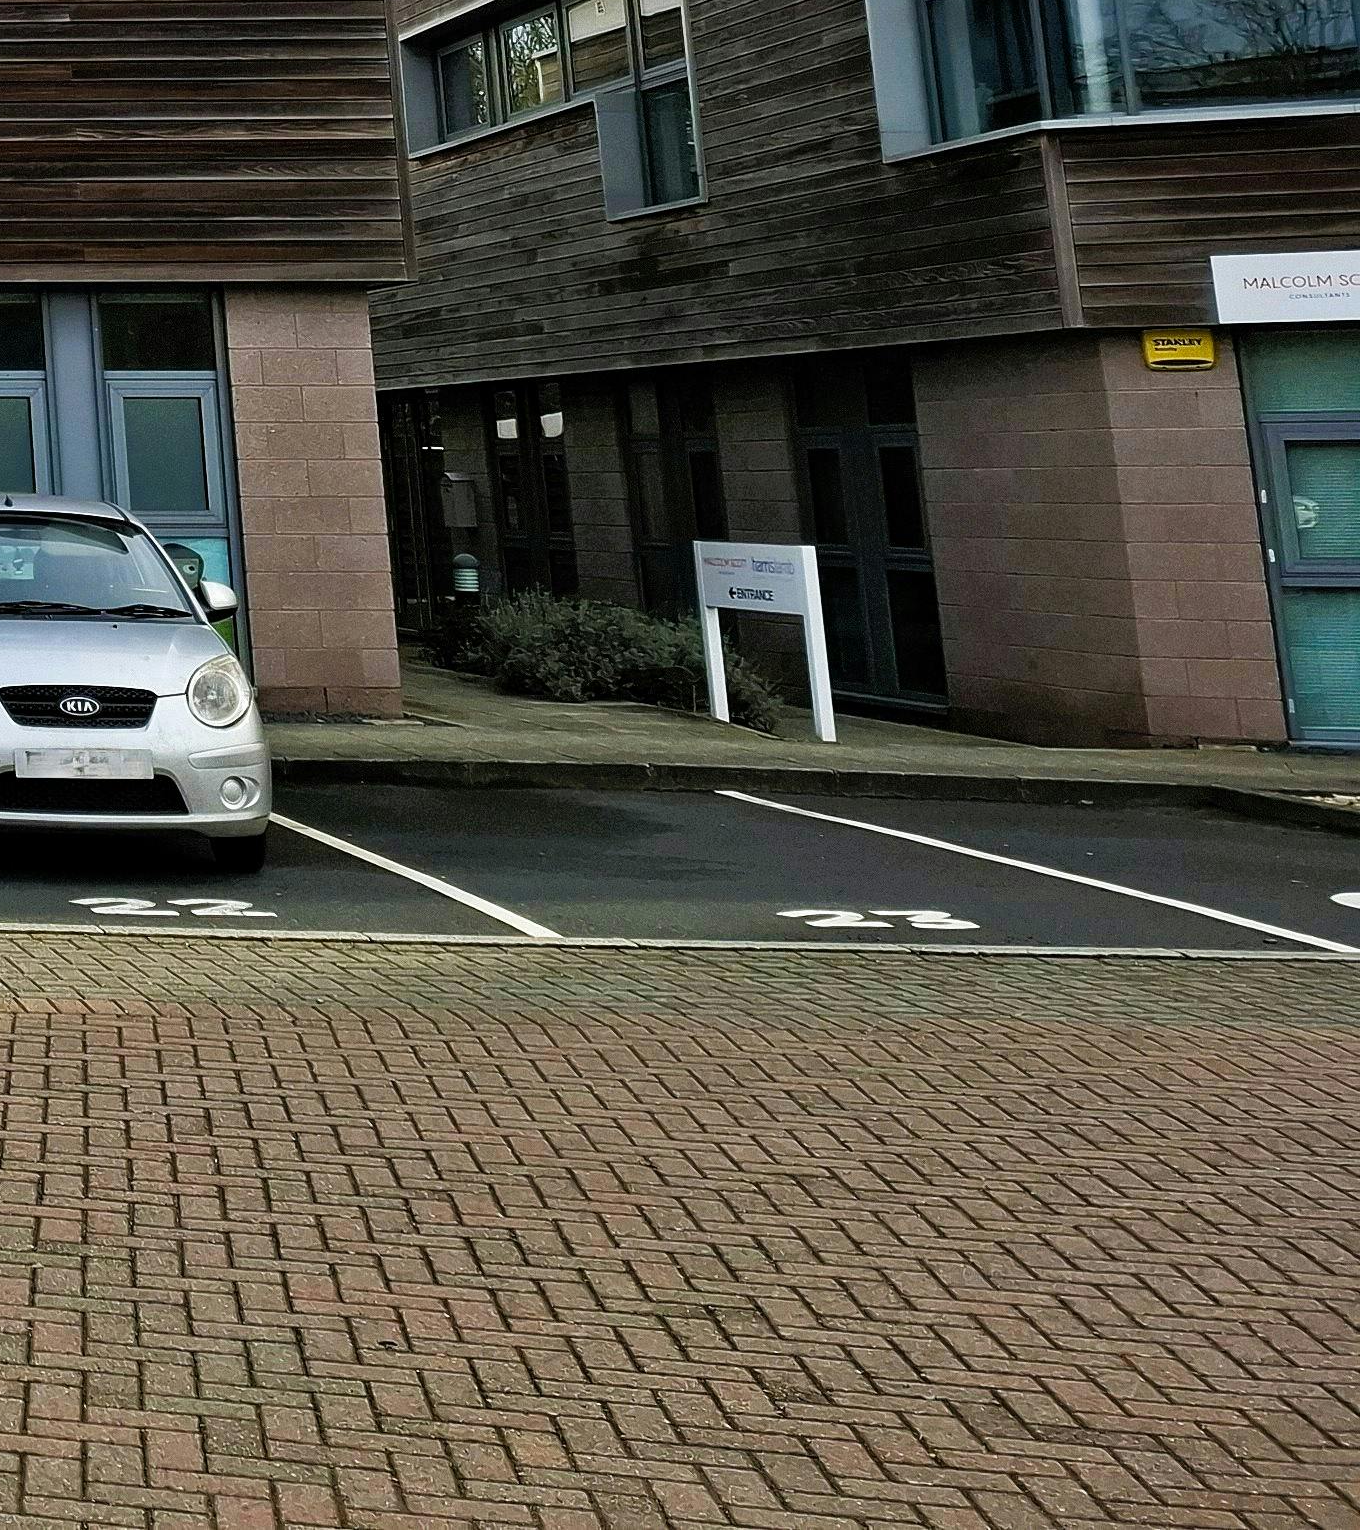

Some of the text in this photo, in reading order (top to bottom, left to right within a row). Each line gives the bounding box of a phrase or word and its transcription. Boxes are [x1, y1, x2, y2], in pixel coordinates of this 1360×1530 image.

[1243, 274, 1334, 289] MALCOLM
[1289, 292, 1351, 300] CONSULTANTS
[1153, 338, 1202, 346] STANLEY
[737, 587, 774, 601] ENTRANCE
[66, 700, 94, 712] KIA
[68, 897, 278, 918] 22
[776, 909, 981, 930] 23
